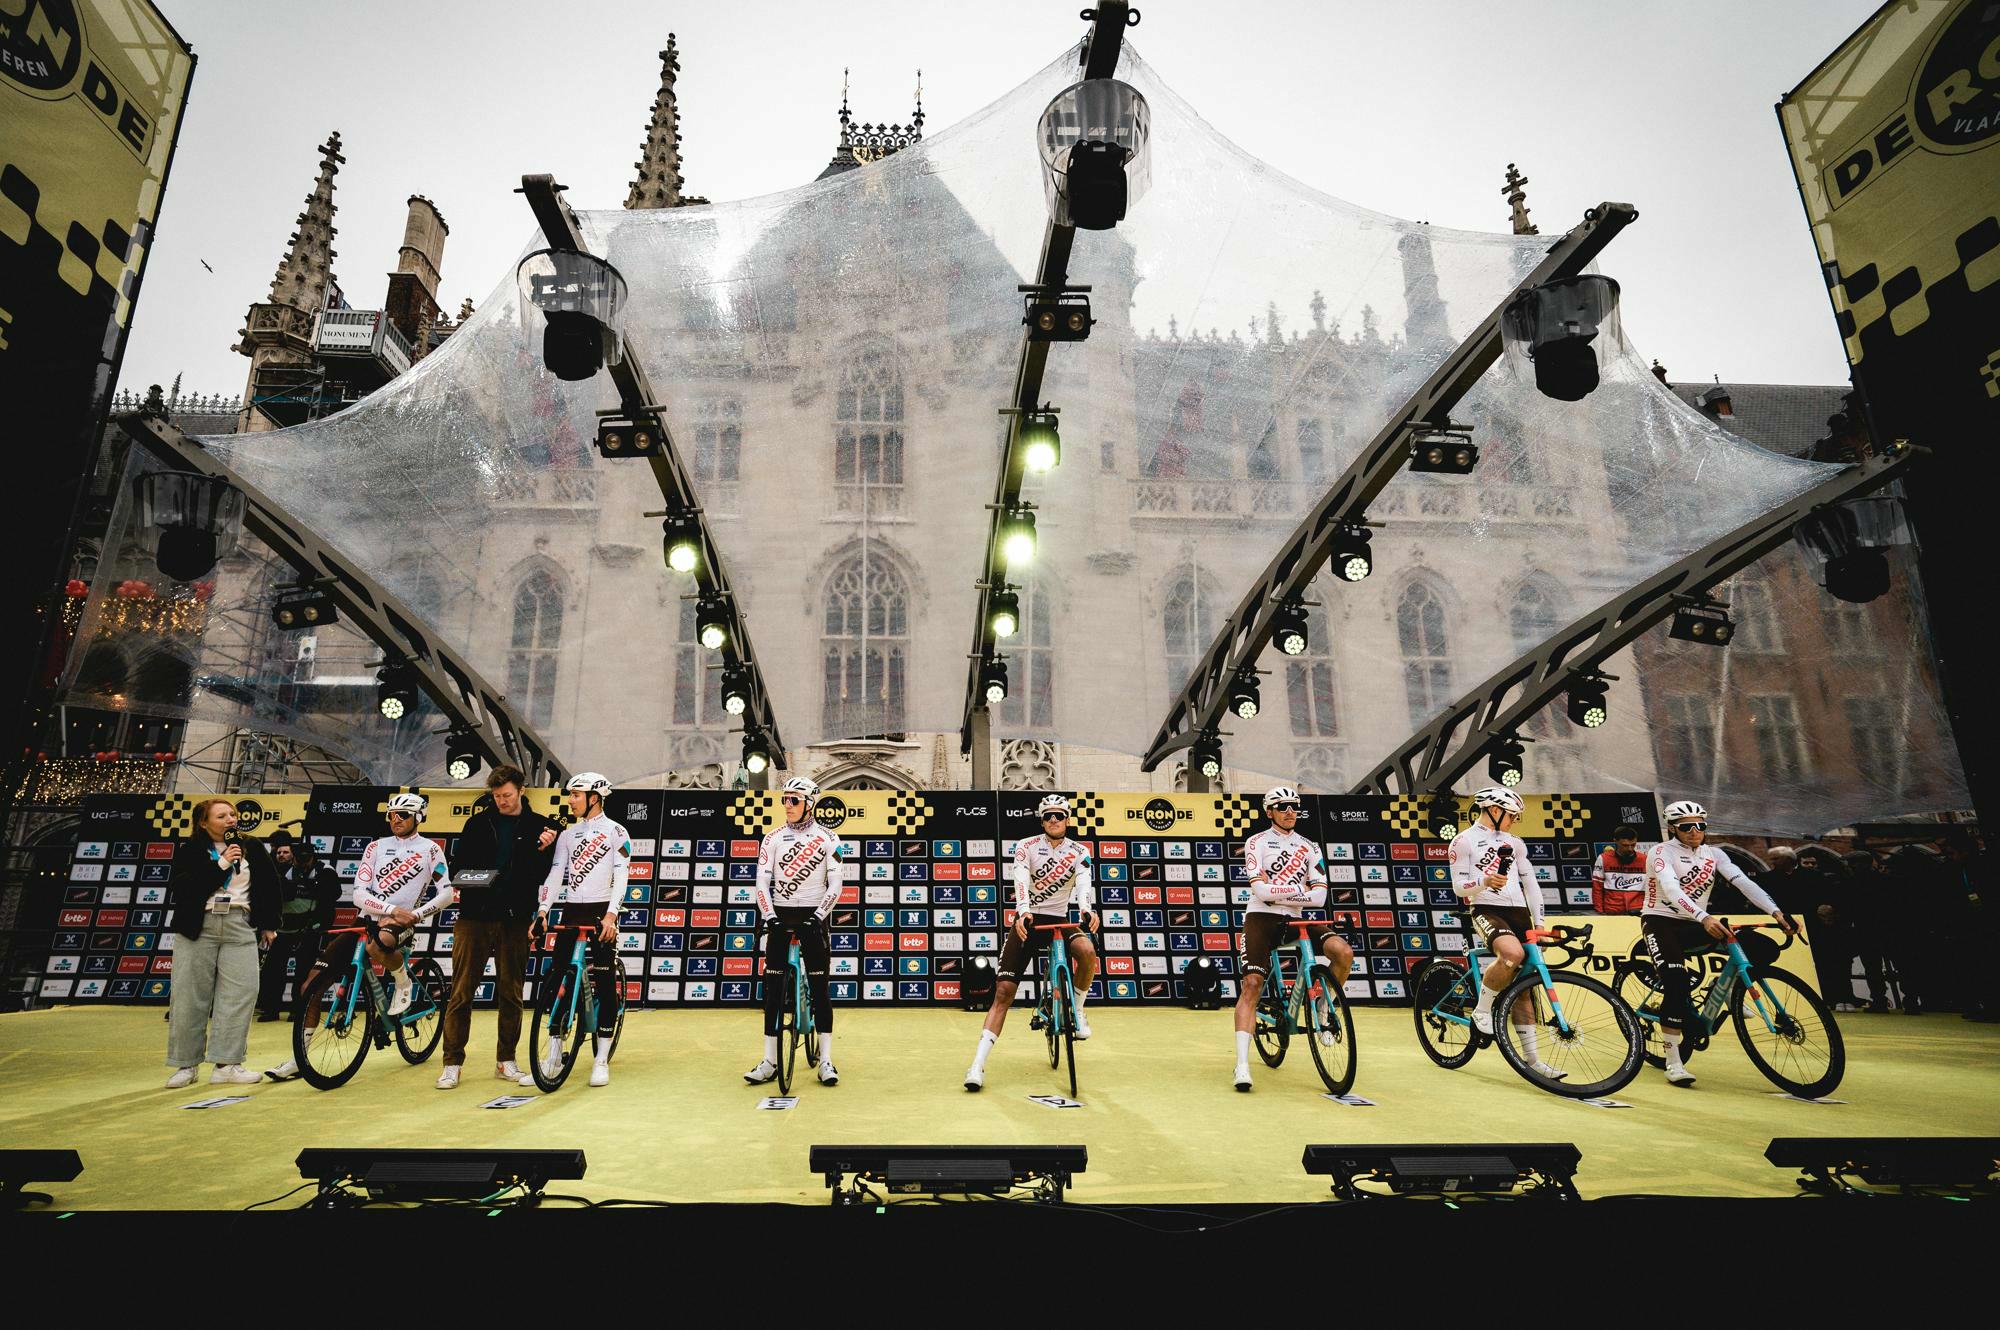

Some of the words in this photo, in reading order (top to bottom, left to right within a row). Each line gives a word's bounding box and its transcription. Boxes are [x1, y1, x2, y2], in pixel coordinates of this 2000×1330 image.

[81, 60, 150, 153] DE
[1834, 113, 1914, 198] DE
[323, 330, 372, 339] MONUMENT
[91, 811, 109, 820] UCI
[264, 812, 280, 820] DE
[453, 806, 471, 815] DE
[670, 809, 688, 817] UCI
[815, 808, 845, 818] RON
[848, 808, 865, 817] DE
[1006, 809, 1022, 817] UCI
[1127, 810, 1143, 819] DE
[1145, 810, 1174, 820] RON
[1177, 810, 1193, 820] DE
[570, 838, 590, 864] AG2R
[574, 833, 608, 871] CITROËN
[778, 841, 805, 870] AG2R
[784, 835, 825, 877] CITROËN
[1103, 846, 1122, 854] lotto
[1265, 850, 1292, 879] AG2R
[1475, 846, 1497, 871] AG2R
[375, 857, 402, 882] AG2R
[378, 852, 422, 889] CITROËN
[571, 843, 611, 892] MONDIALE
[781, 847, 826, 900] MONDIALE
[972, 867, 991, 876] lotto
[1030, 857, 1058, 883] AG2R
[1035, 852, 1076, 891] CITROËN
[378, 864, 423, 901] ONDIALE
[776, 879, 788, 893] LA
[1614, 875, 1643, 889] Casera
[1138, 891, 1157, 900] lotto
[64, 914, 87, 922] lotto
[660, 914, 680, 922] lotto
[903, 938, 924, 946] lotto
[1110, 961, 1129, 970] lotto
[1708, 956, 1729, 973] D
[938, 986, 959, 995] lotto
